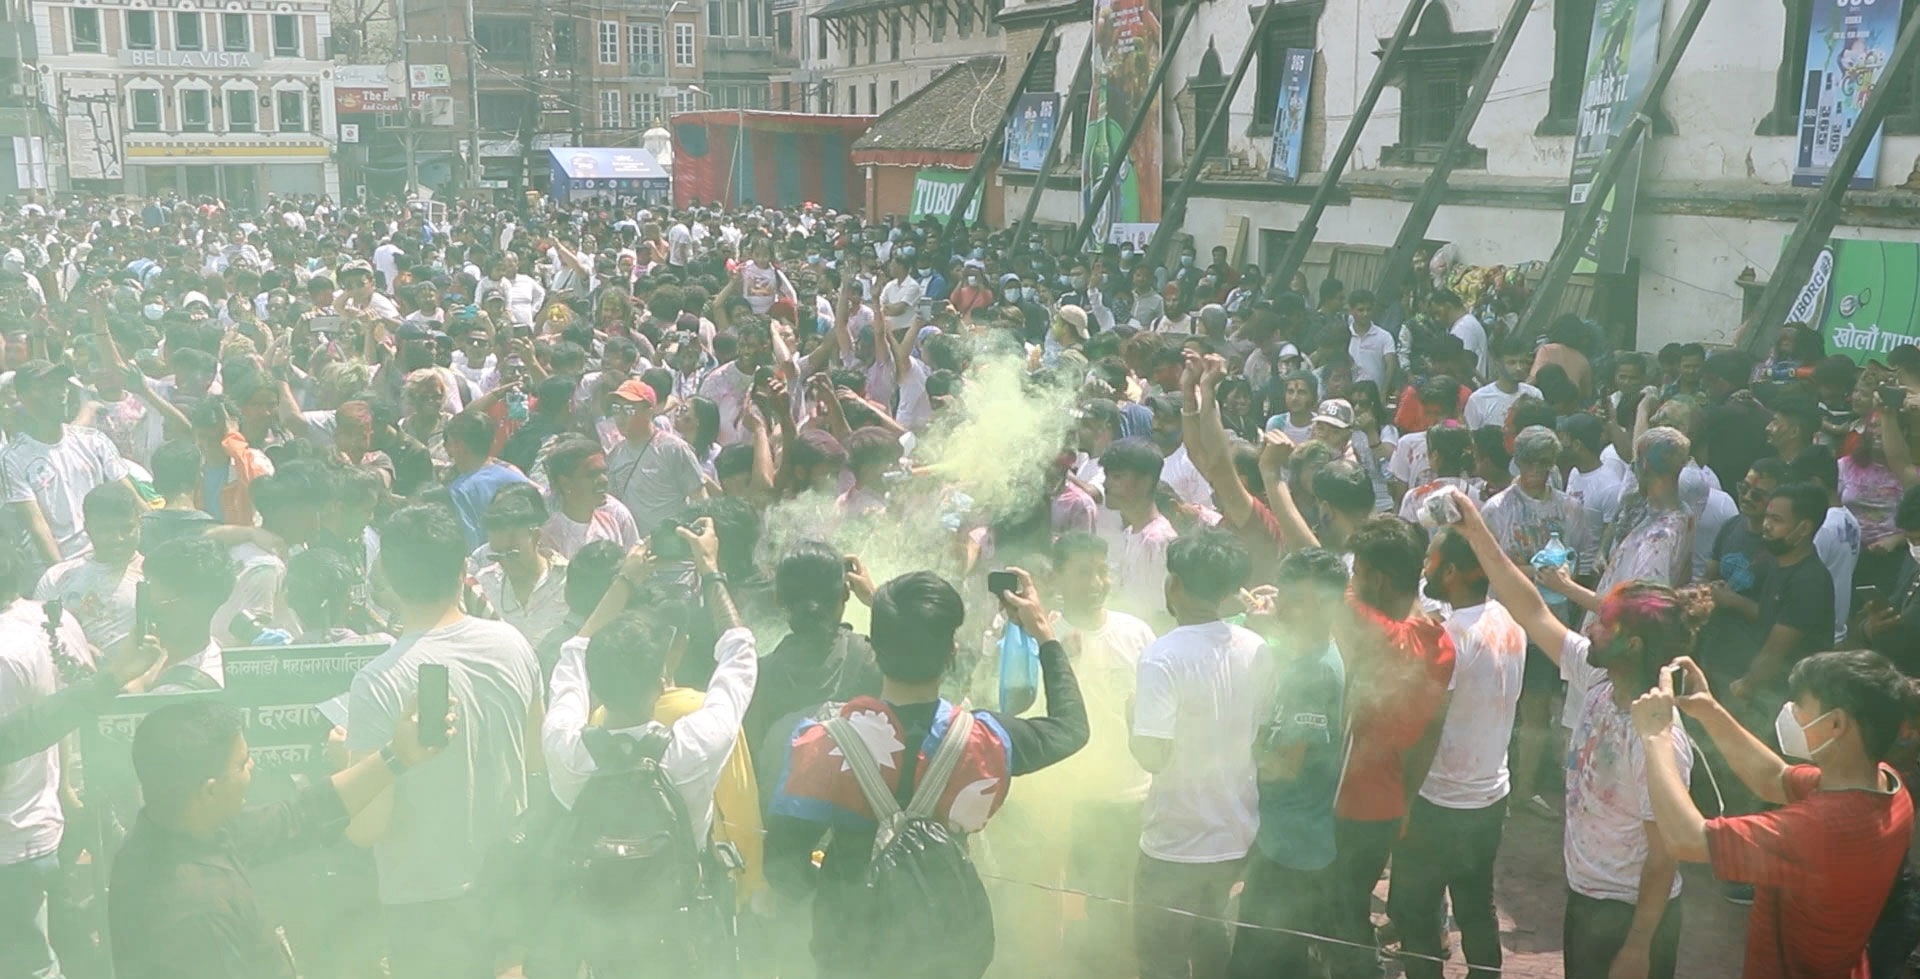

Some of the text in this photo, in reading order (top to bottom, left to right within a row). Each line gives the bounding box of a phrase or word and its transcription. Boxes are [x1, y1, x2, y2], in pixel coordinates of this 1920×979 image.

[132, 50, 250, 67] BELLA VISTA
[362, 90, 381, 101] The
[915, 179, 980, 219] TUBOG
